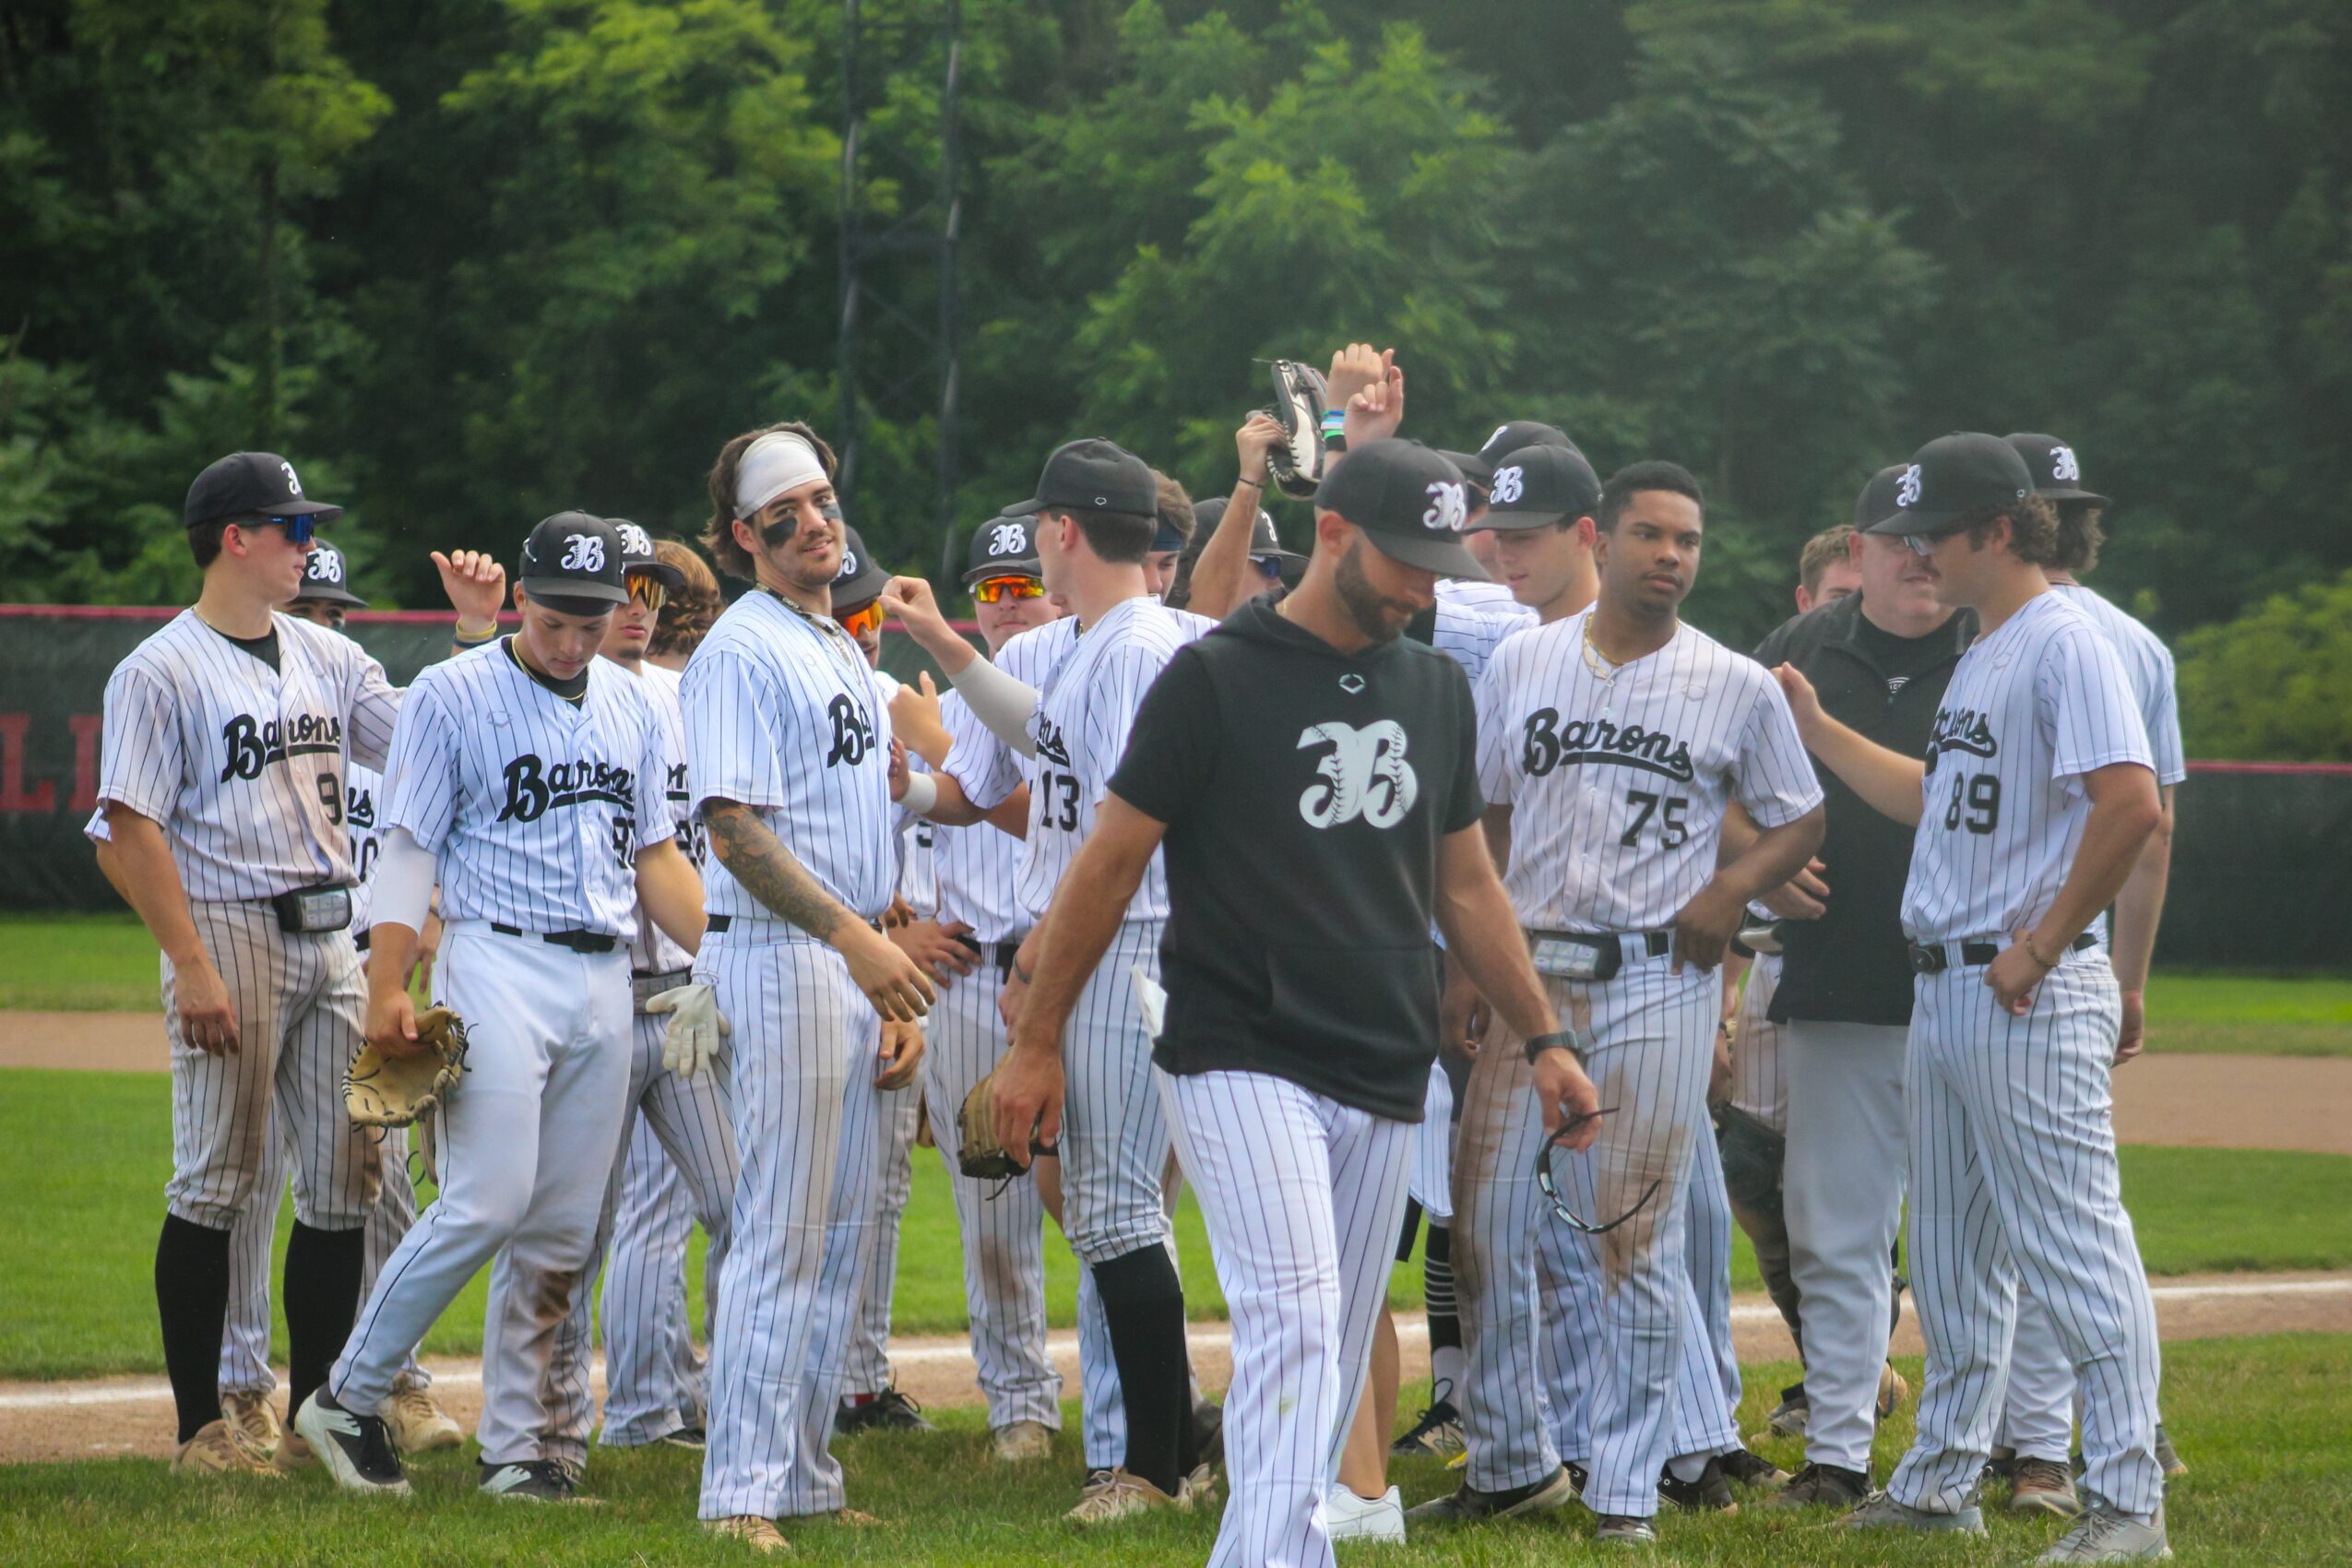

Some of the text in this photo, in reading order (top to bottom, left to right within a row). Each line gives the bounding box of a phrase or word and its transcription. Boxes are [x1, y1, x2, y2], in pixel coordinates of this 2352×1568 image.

[1522, 707, 1694, 783] Barons
[316, 772, 342, 826] 9
[1041, 770, 1079, 831] 13
[1620, 790, 1689, 849] 75
[1944, 772, 2001, 835] 89
